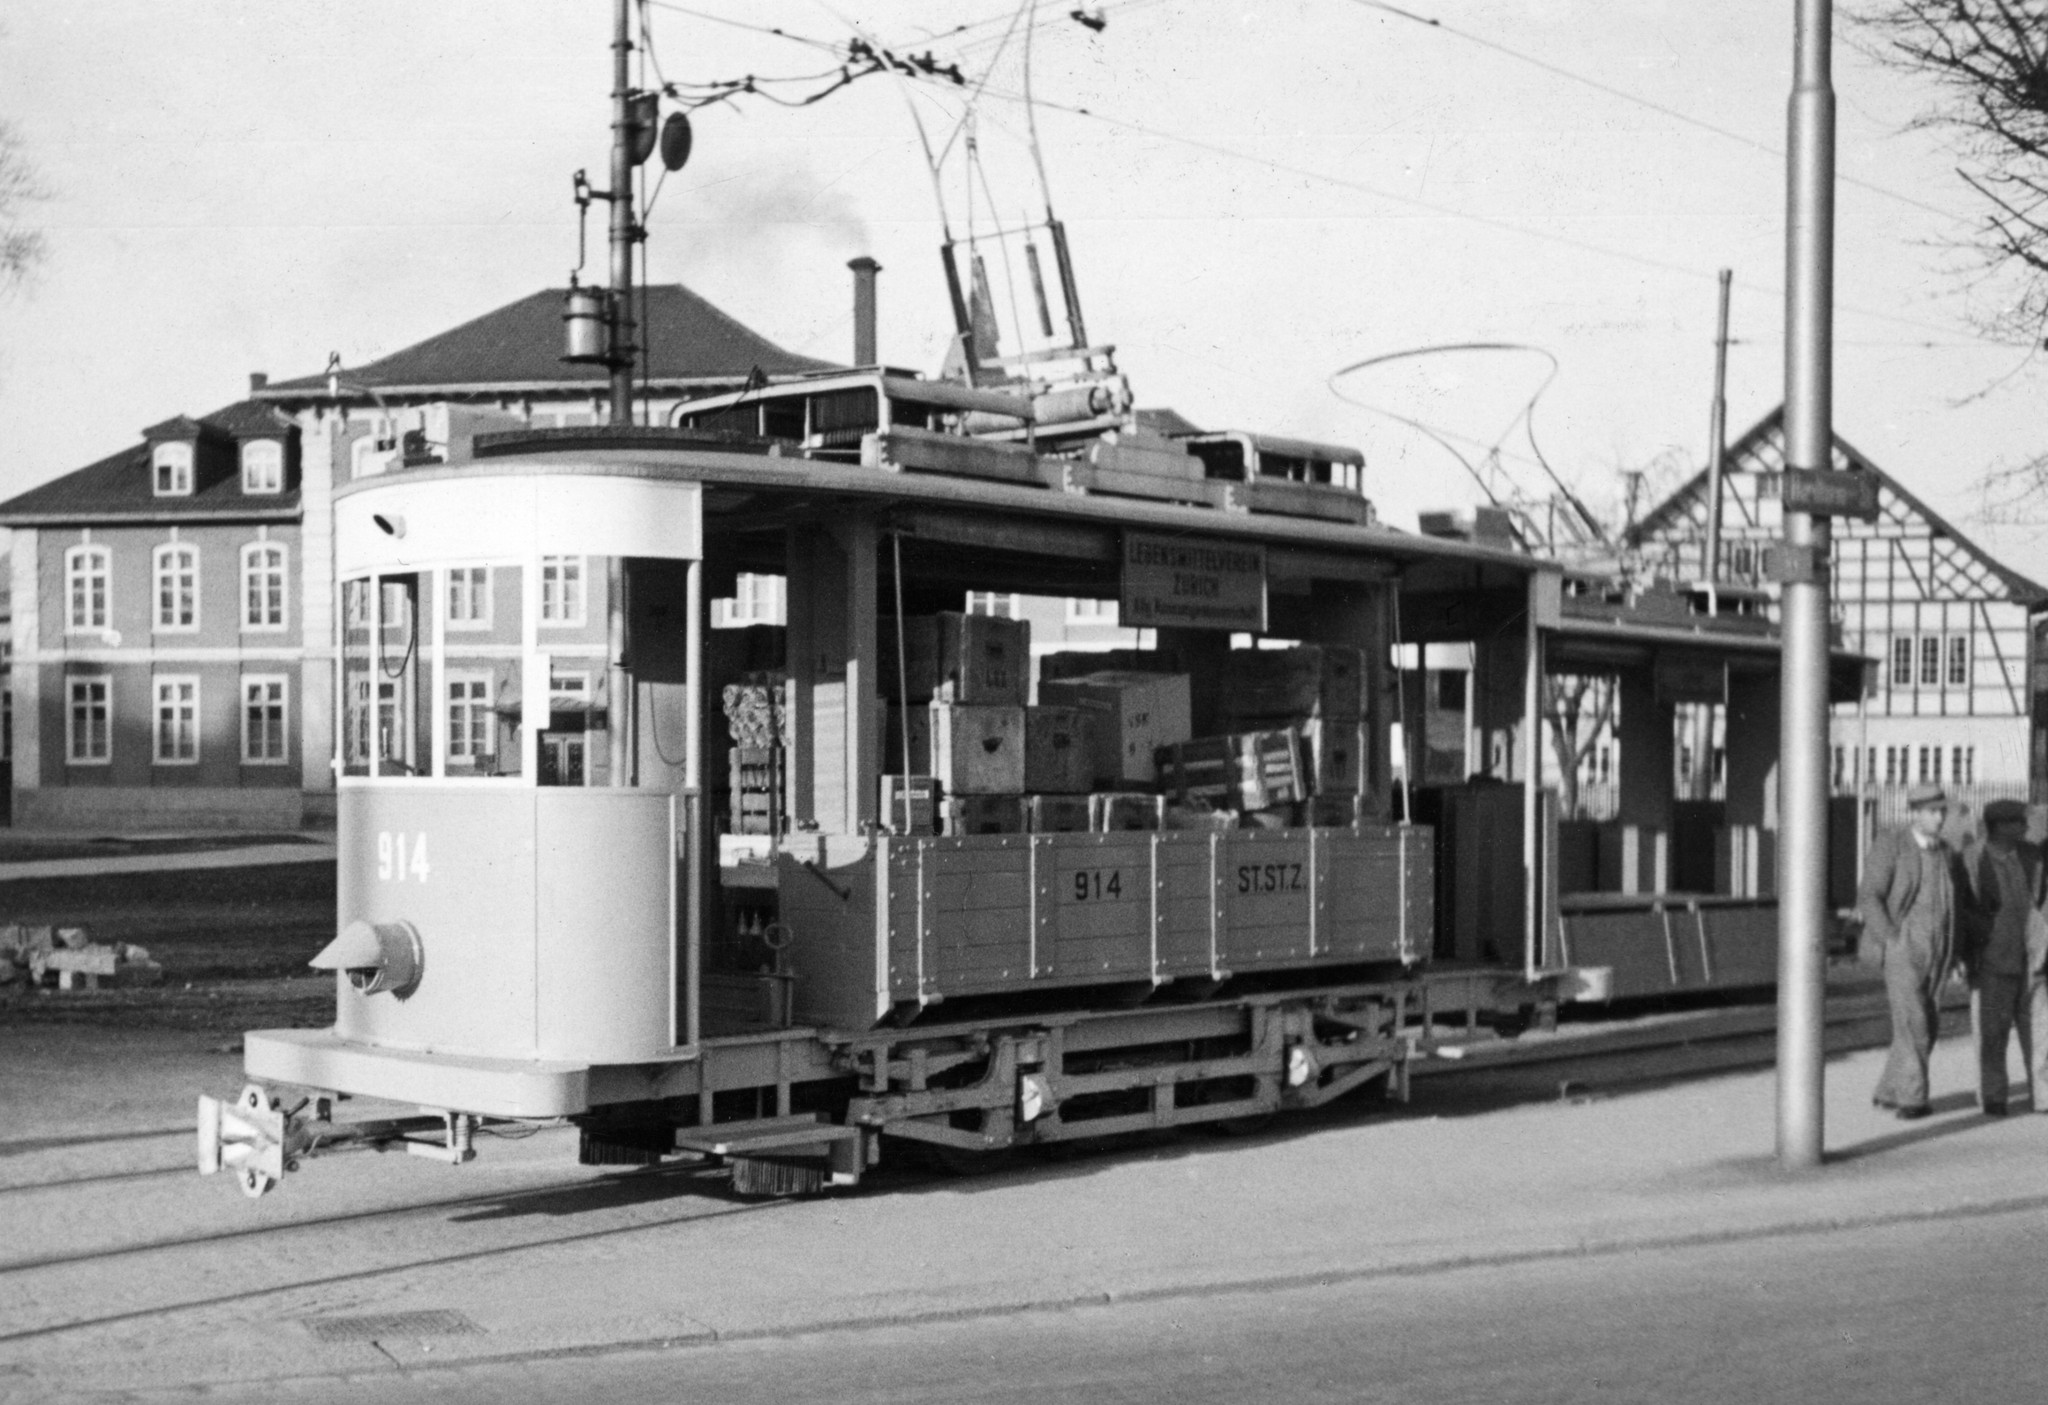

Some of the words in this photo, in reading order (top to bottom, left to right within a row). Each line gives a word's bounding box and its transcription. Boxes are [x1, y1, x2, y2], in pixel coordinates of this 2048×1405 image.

[377, 830, 430, 884] 914
[1074, 869, 1122, 902] 914
[1239, 862, 1307, 895] ST.ST.Z.
